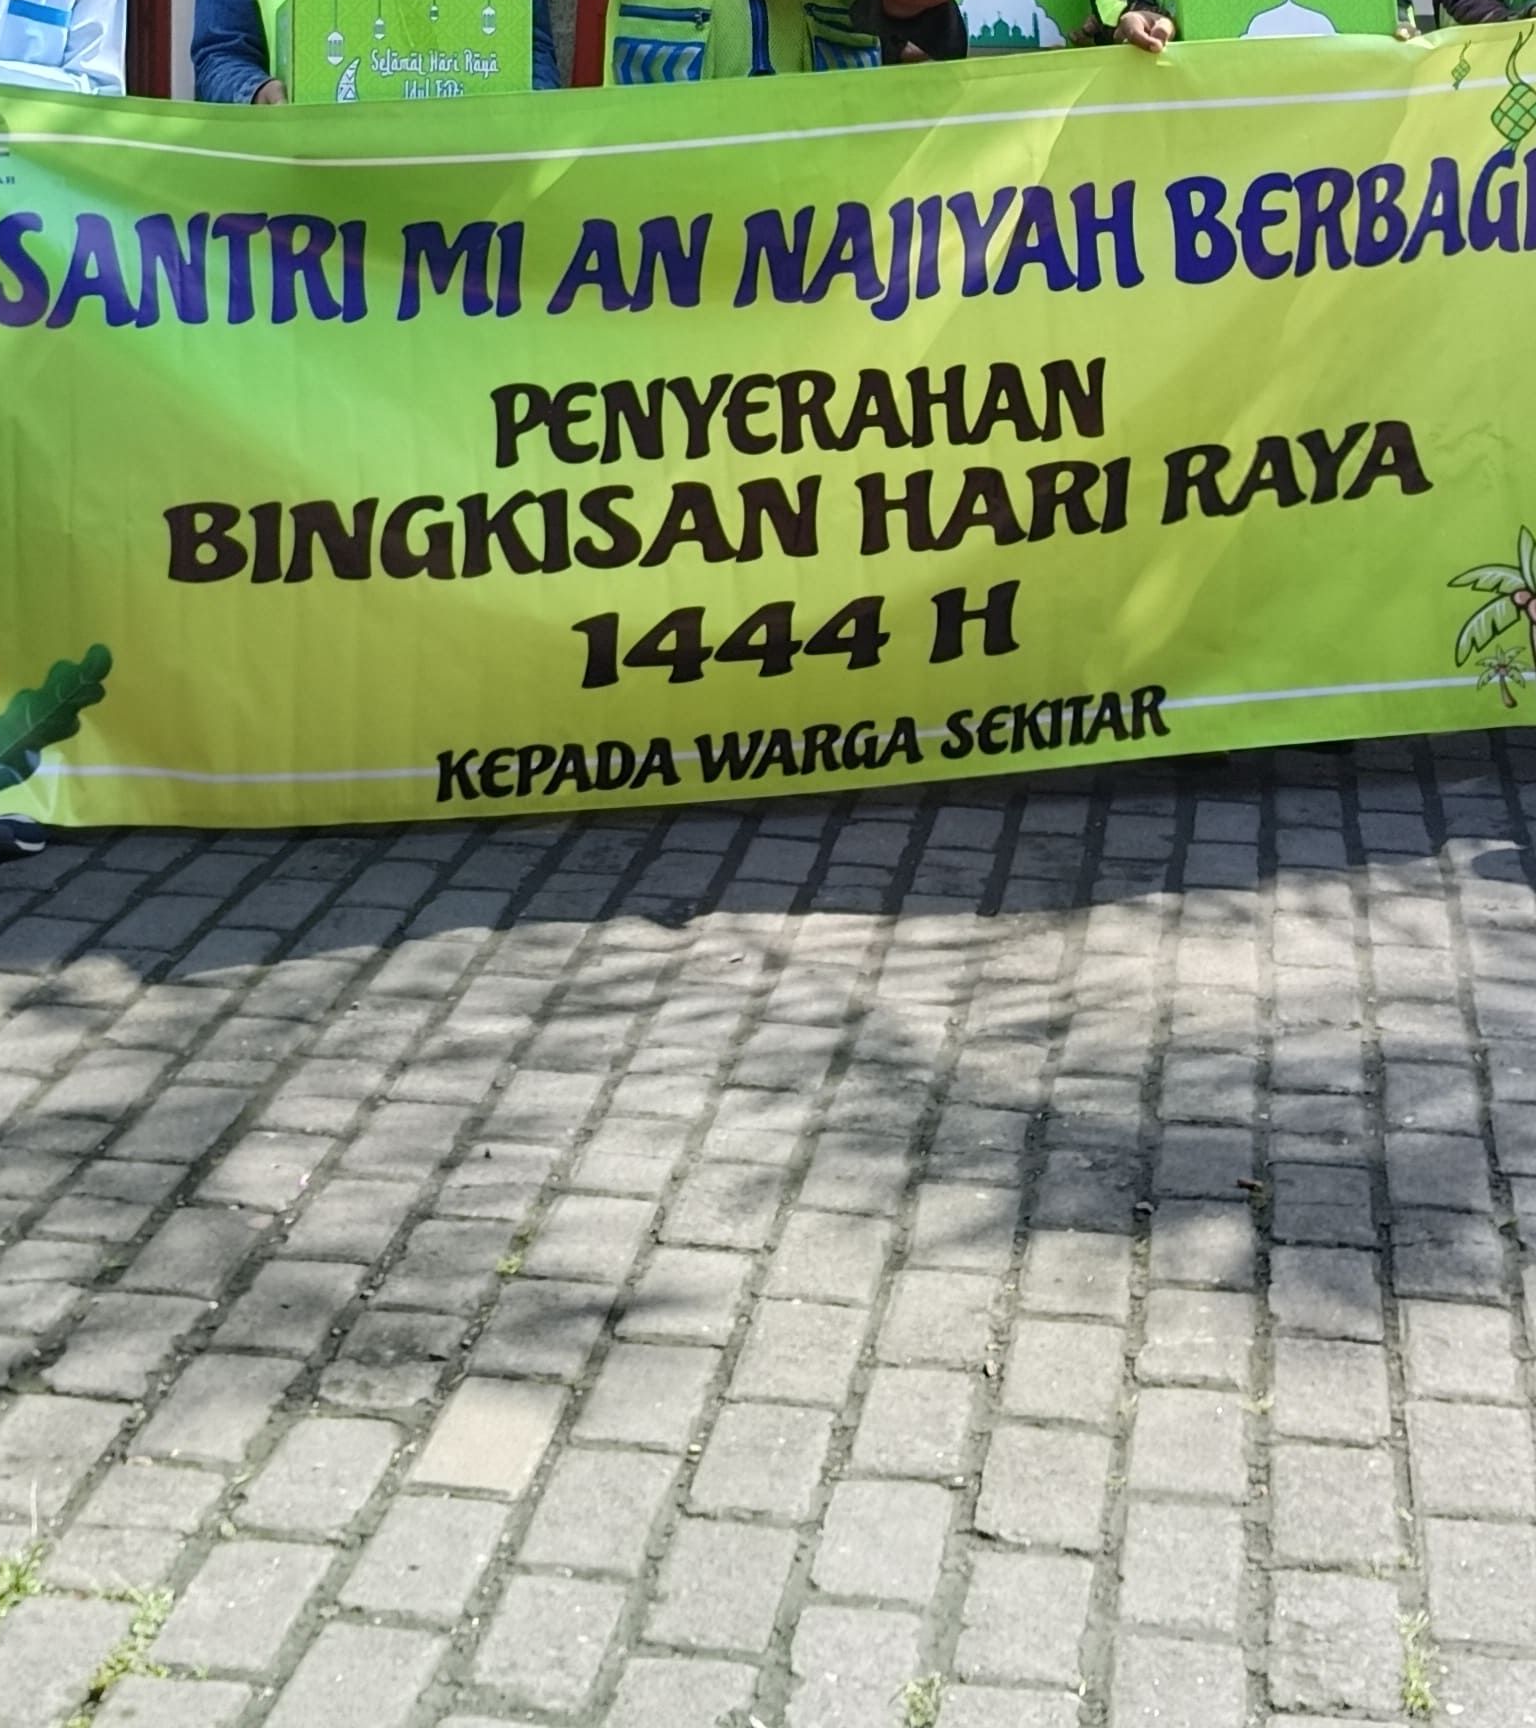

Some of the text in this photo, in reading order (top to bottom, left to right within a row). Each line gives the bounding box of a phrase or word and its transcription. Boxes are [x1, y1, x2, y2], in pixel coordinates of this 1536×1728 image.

[397, 218, 524, 323] MI
[547, 212, 713, 313] AN
[732, 178, 1146, 321] NAJIYAH
[489, 355, 1106, 469] PENYERAHAN
[161, 418, 1434, 585] BINGKISAN HARI RAYA
[571, 578, 1020, 690] 1444 H
[435, 683, 1171, 804] KEPADA WARGA SEKITAR
